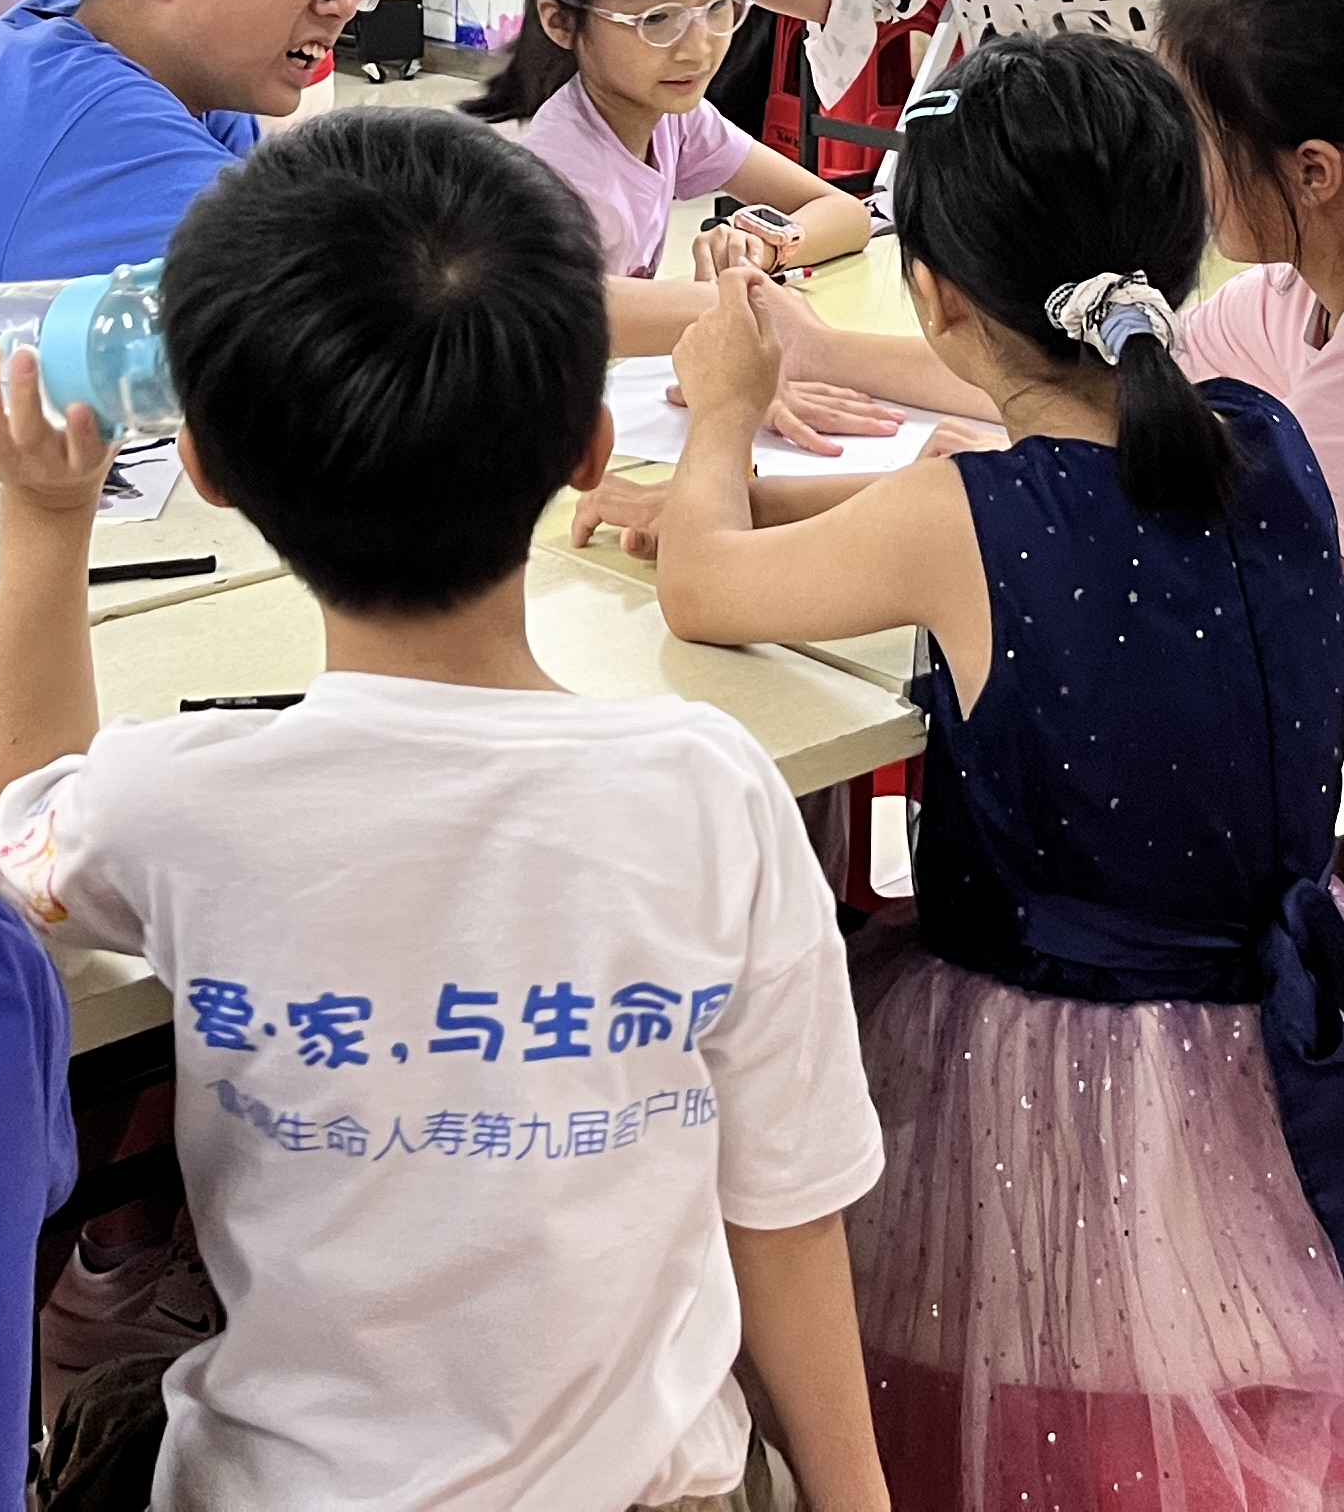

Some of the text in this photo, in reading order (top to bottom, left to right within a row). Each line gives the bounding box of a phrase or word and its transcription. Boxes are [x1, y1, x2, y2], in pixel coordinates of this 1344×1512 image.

[204, 1078, 720, 1162] 生命人寿第九届客户服
